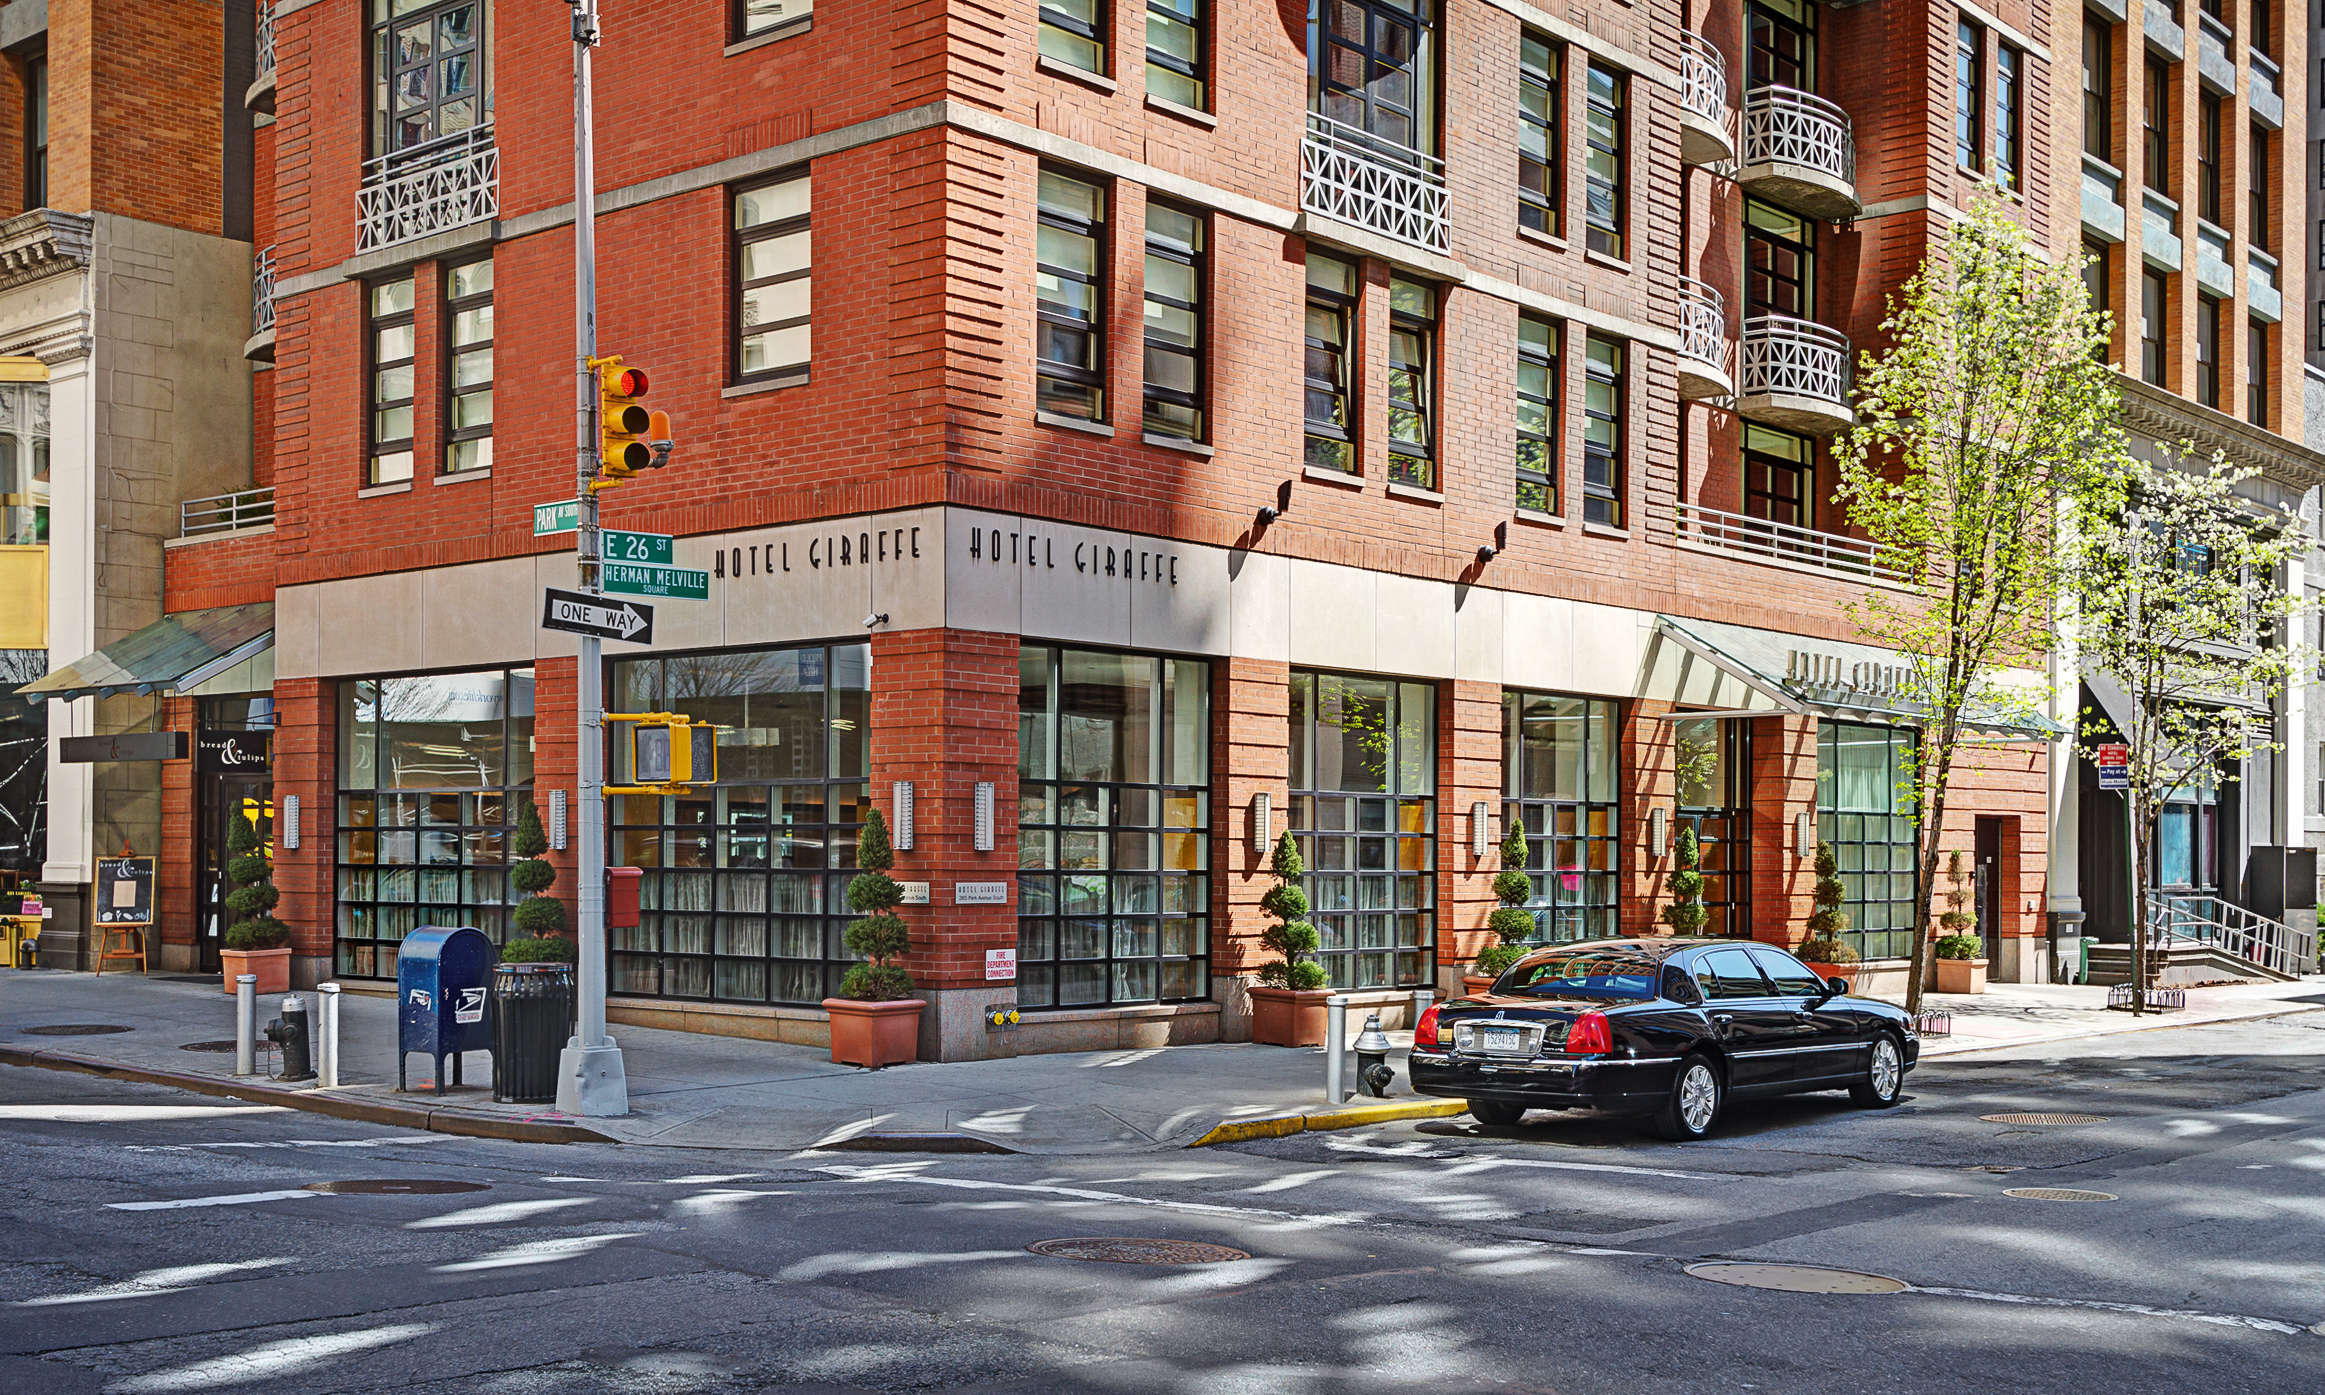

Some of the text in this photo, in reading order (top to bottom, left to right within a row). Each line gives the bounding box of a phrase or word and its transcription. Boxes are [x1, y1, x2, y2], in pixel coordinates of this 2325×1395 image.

[536, 507, 557, 531] PARK
[607, 534, 667, 560] E 26 ST
[714, 527, 920, 578] HOTEL GIRAFFE
[970, 527, 1178, 585] HOTEL GIRAFFE
[605, 565, 705, 588] HERMAN MELVILLE
[643, 585, 669, 594] SQUARE
[561, 603, 591, 622] ONE
[606, 611, 637, 630] WAY
[221, 738, 242, 764] &
[237, 753, 264, 763] tulips
[987, 959, 1014, 968] DEPARTMENT
[996, 951, 1006, 959] FIRE
[987, 969, 1014, 978] CONNECTION
